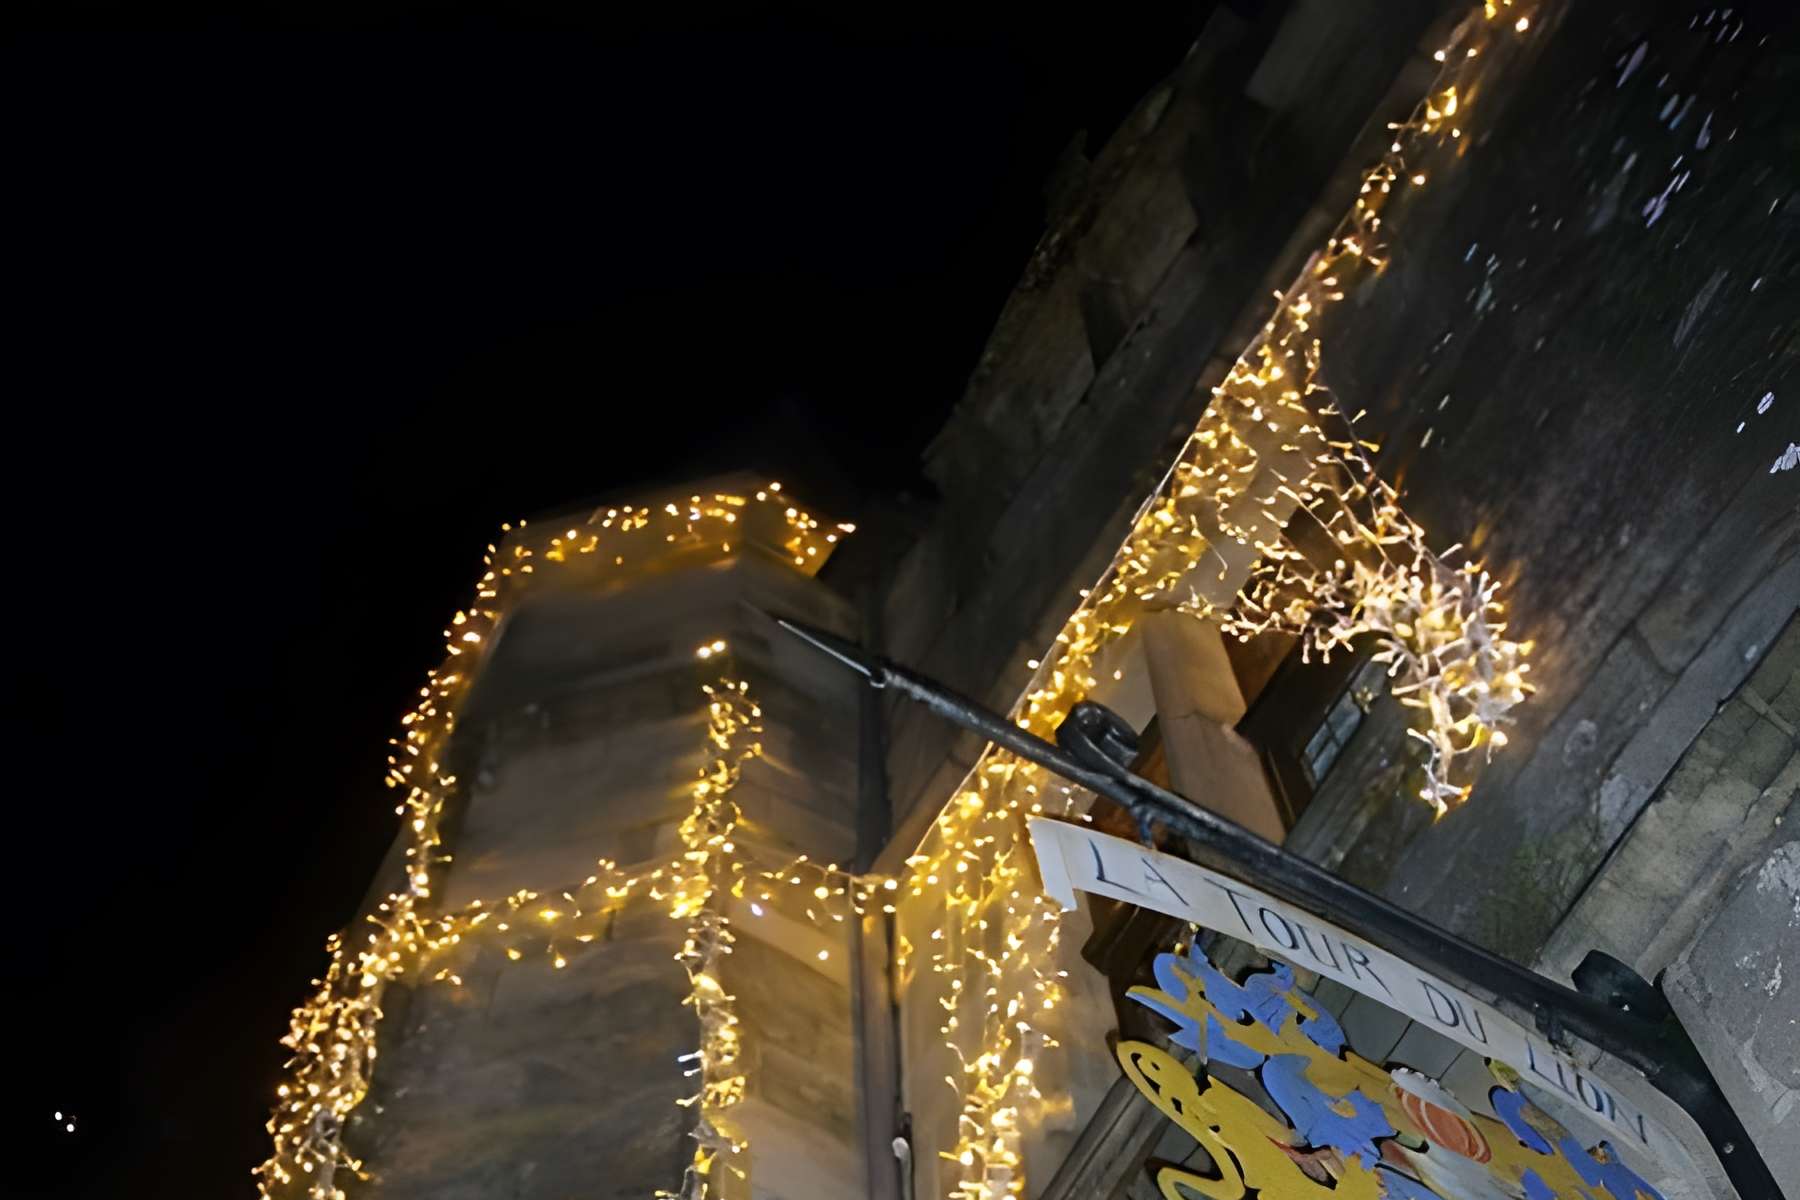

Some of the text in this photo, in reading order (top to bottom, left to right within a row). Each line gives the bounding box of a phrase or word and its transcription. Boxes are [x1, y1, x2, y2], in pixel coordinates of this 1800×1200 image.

[1088, 837, 1190, 908] LA
[1203, 877, 1394, 998] TOUR
[1417, 977, 1489, 1046] DU
